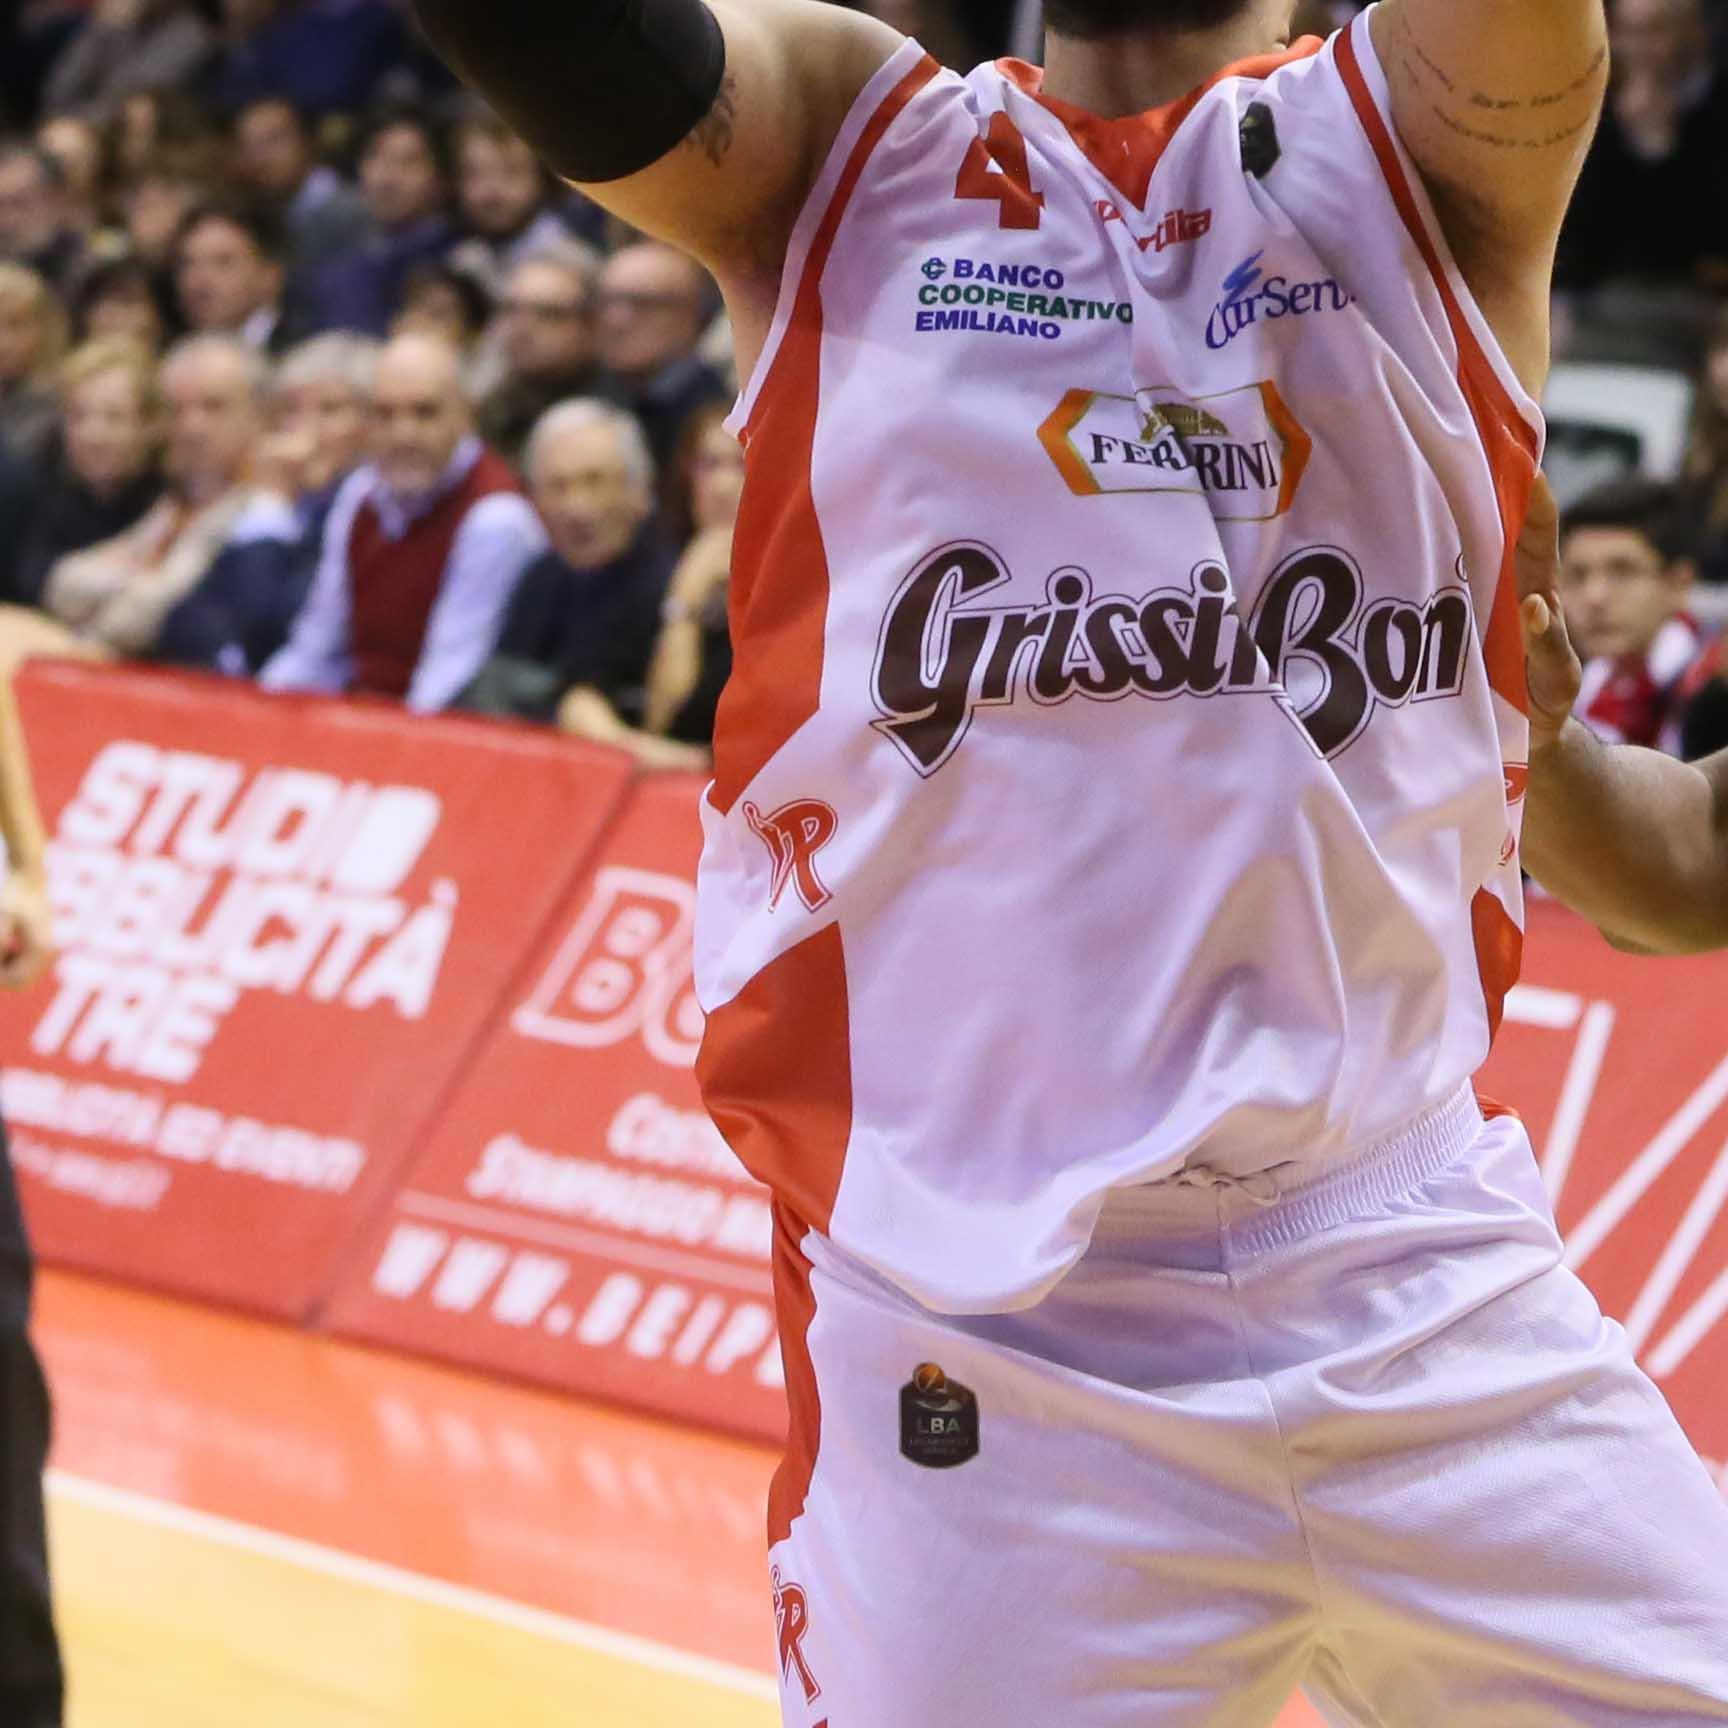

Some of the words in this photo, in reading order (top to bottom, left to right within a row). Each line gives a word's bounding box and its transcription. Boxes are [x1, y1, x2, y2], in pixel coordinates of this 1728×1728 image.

[954, 110, 1044, 230] 4
[918, 284, 1133, 325] COOPERATIVO
[953, 258, 1064, 290] BANCO
[915, 311, 1061, 340] EMILIANO
[1089, 431, 1278, 492] FERRINI
[58, 739, 442, 894] STUDIO
[31, 953, 244, 1084] TRE
[374, 1223, 785, 1387] WWW.BEIP
[916, 1416, 961, 1436] LBA
